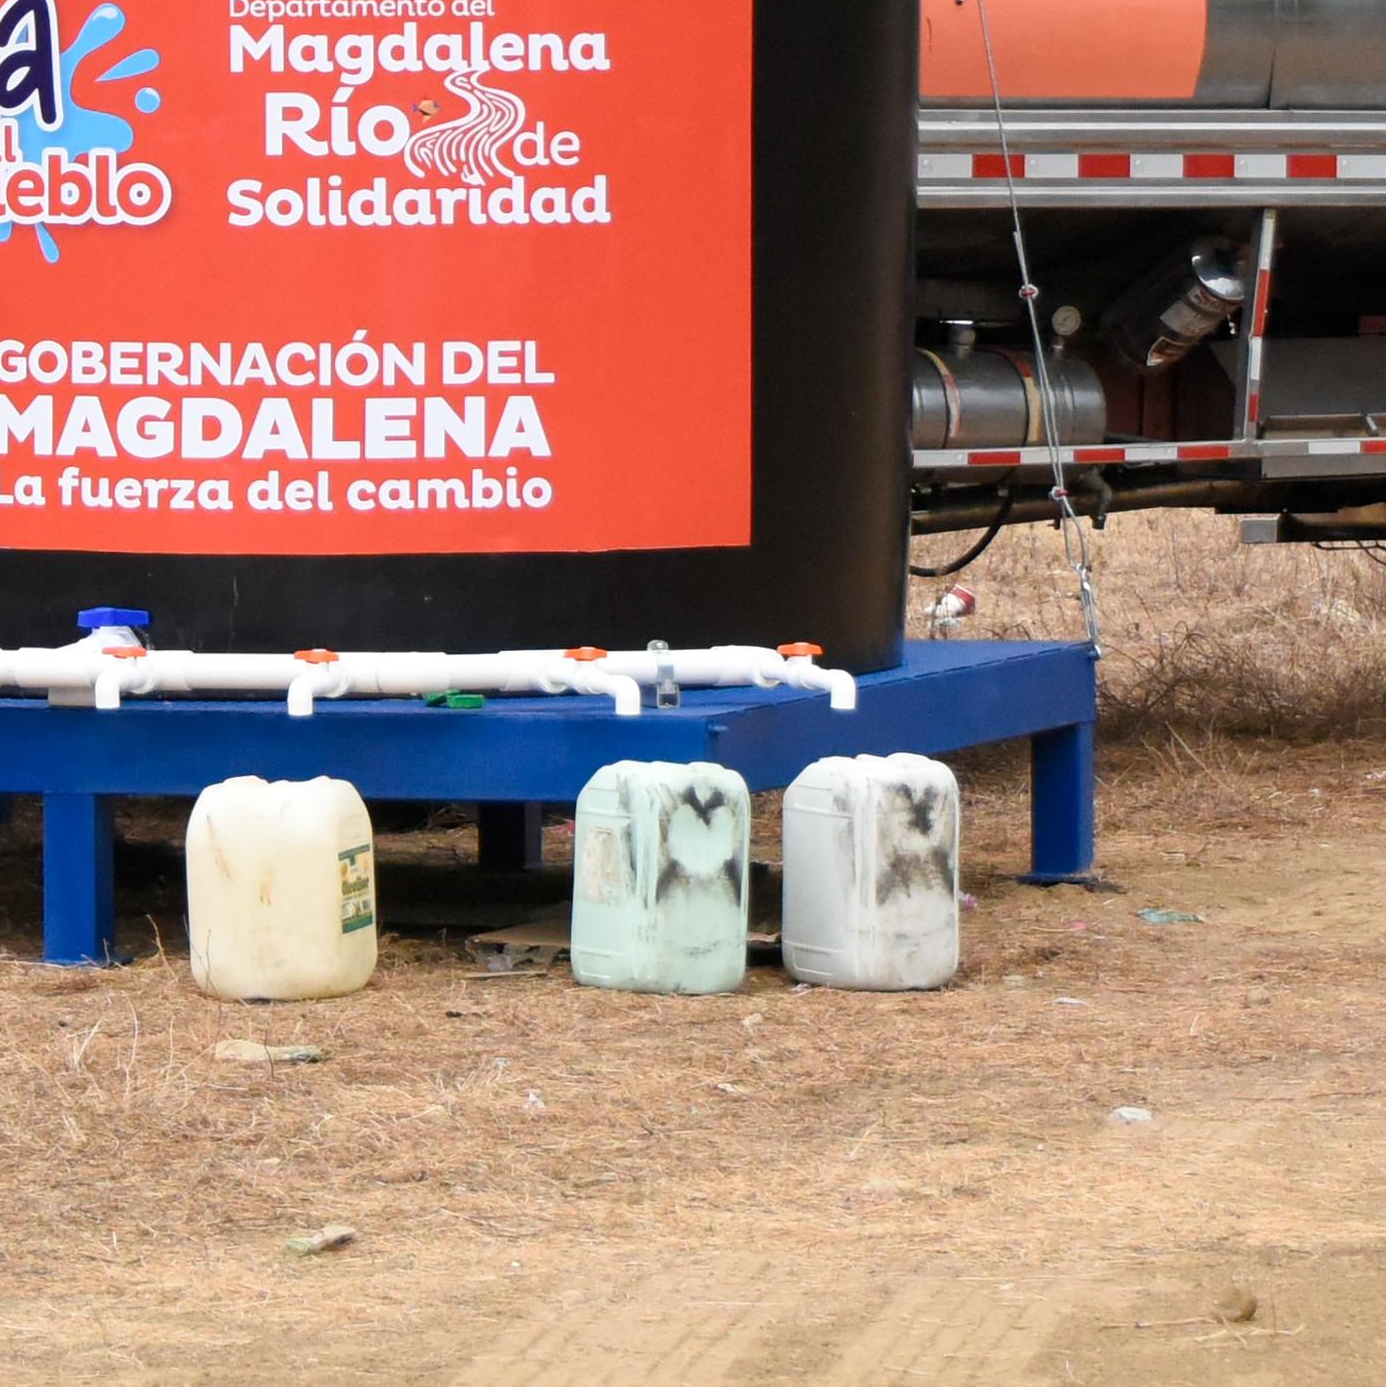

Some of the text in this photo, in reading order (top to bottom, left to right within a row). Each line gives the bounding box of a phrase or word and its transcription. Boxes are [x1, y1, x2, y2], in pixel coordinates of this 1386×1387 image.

[229, 21, 610, 86] Magdalena
[264, 86, 581, 167] Río de
[227, 174, 611, 227] Solidaridad
[441, 339, 555, 384] DEL
[56, 468, 233, 510] fuerza
[246, 469, 332, 510] del
[347, 466, 553, 510] cambio
